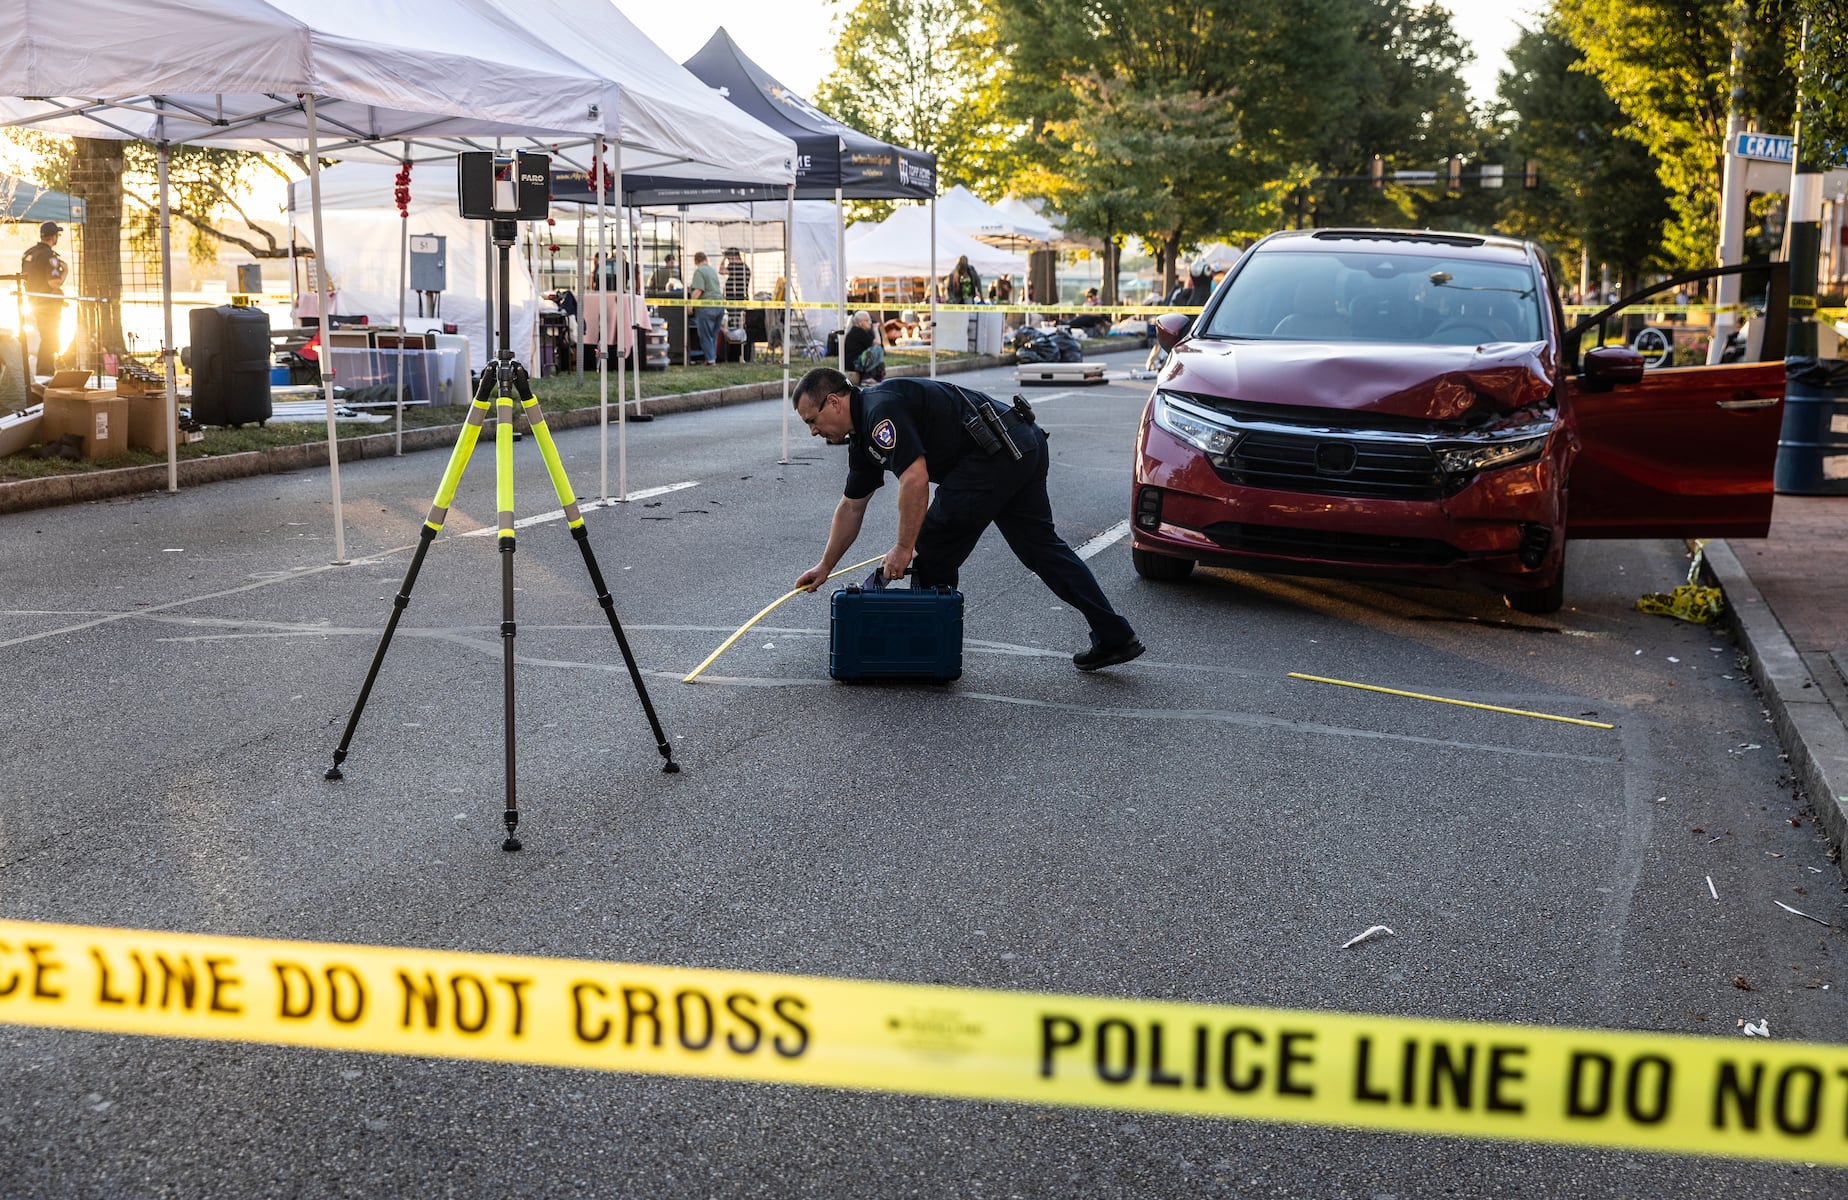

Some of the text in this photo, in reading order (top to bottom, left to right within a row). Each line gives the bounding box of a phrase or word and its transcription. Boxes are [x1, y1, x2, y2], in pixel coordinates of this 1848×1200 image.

[521, 174, 545, 182] FARO
[90, 946, 242, 1014] LINE
[272, 961, 366, 1026] DO
[397, 968, 533, 1038] NOT
[571, 980, 813, 1060] CROSS
[1039, 1014, 1318, 1099] POLICE
[1354, 1034, 1529, 1117] LINE
[1566, 1049, 1674, 1126] DO
